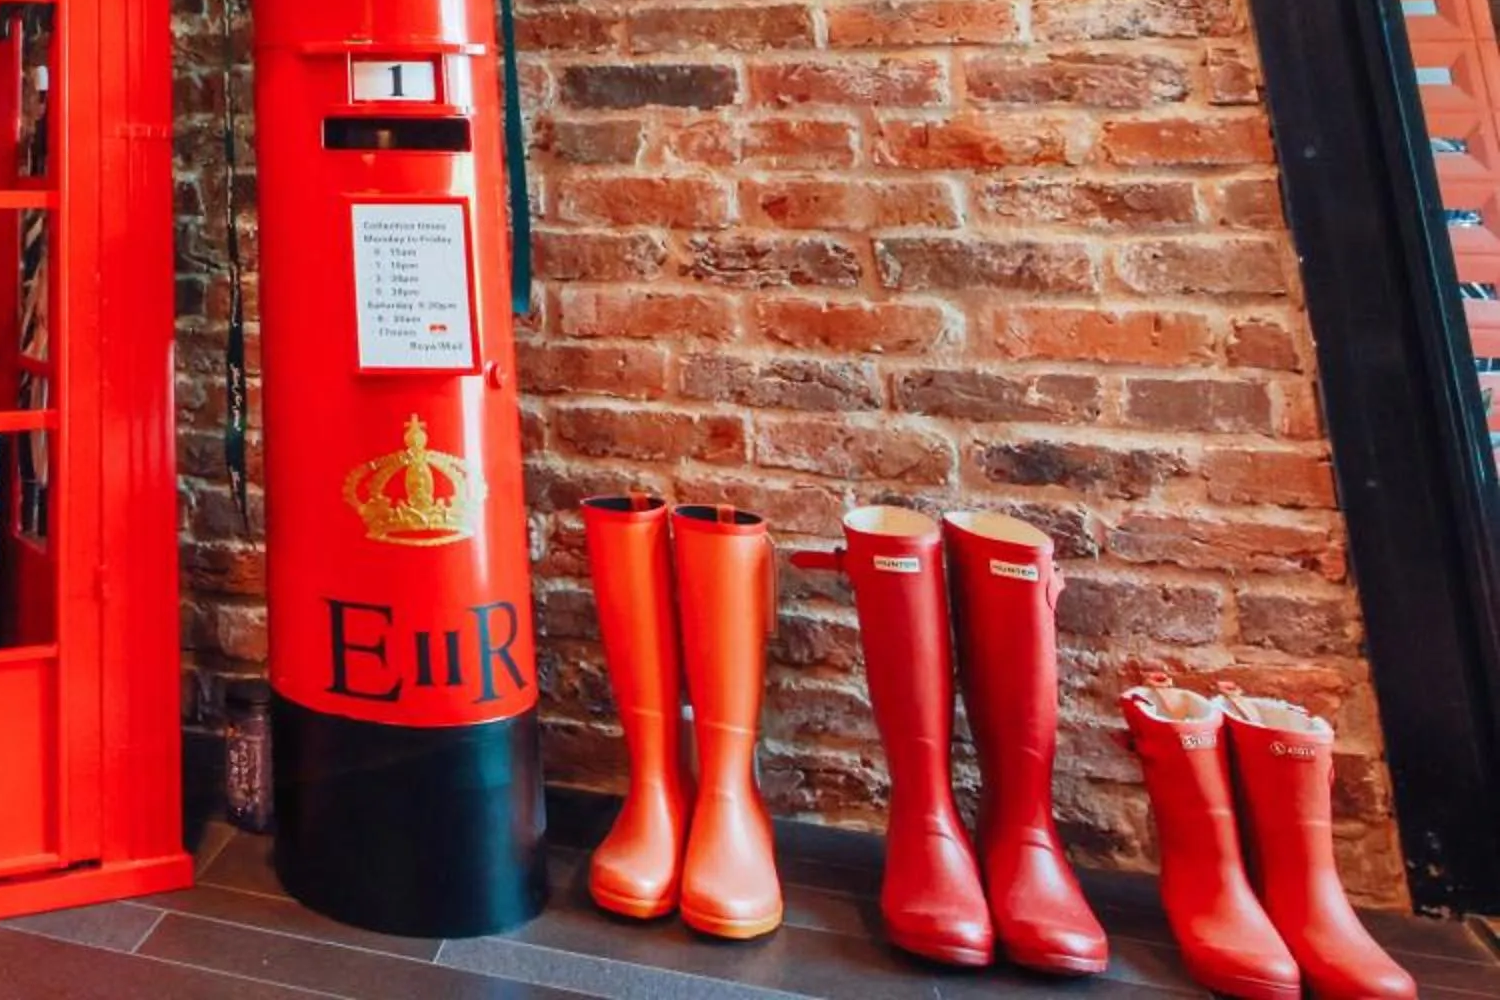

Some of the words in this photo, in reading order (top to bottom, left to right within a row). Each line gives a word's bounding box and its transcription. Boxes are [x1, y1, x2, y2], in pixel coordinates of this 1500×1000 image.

[388, 64, 404, 96] 1
[363, 234, 404, 245] Monday
[419, 234, 452, 245] Friday
[367, 301, 413, 311] Saturday
